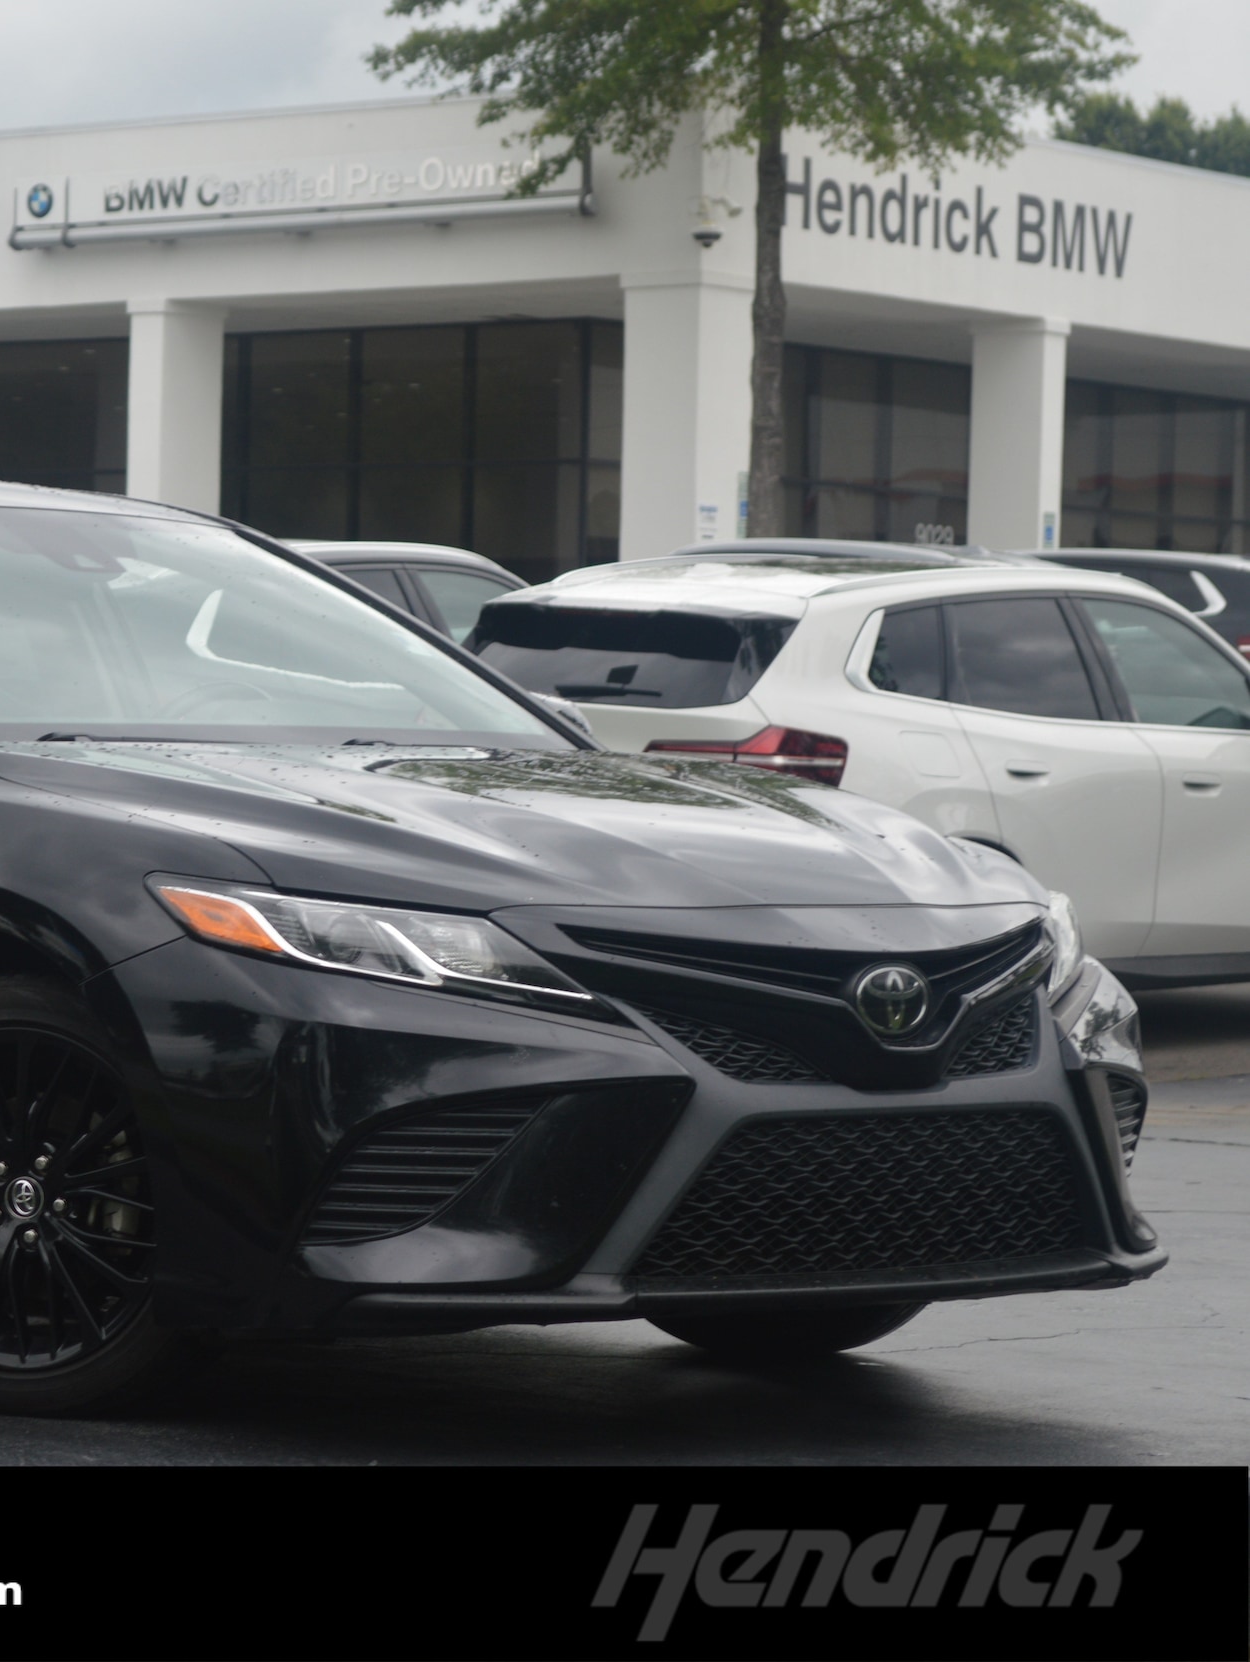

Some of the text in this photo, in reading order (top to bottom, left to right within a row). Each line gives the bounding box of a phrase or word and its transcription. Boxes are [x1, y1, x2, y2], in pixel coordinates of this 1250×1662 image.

[104, 176, 188, 212] BMW
[197, 164, 334, 207] Certified
[780, 153, 1132, 278] Hendrick BMW
